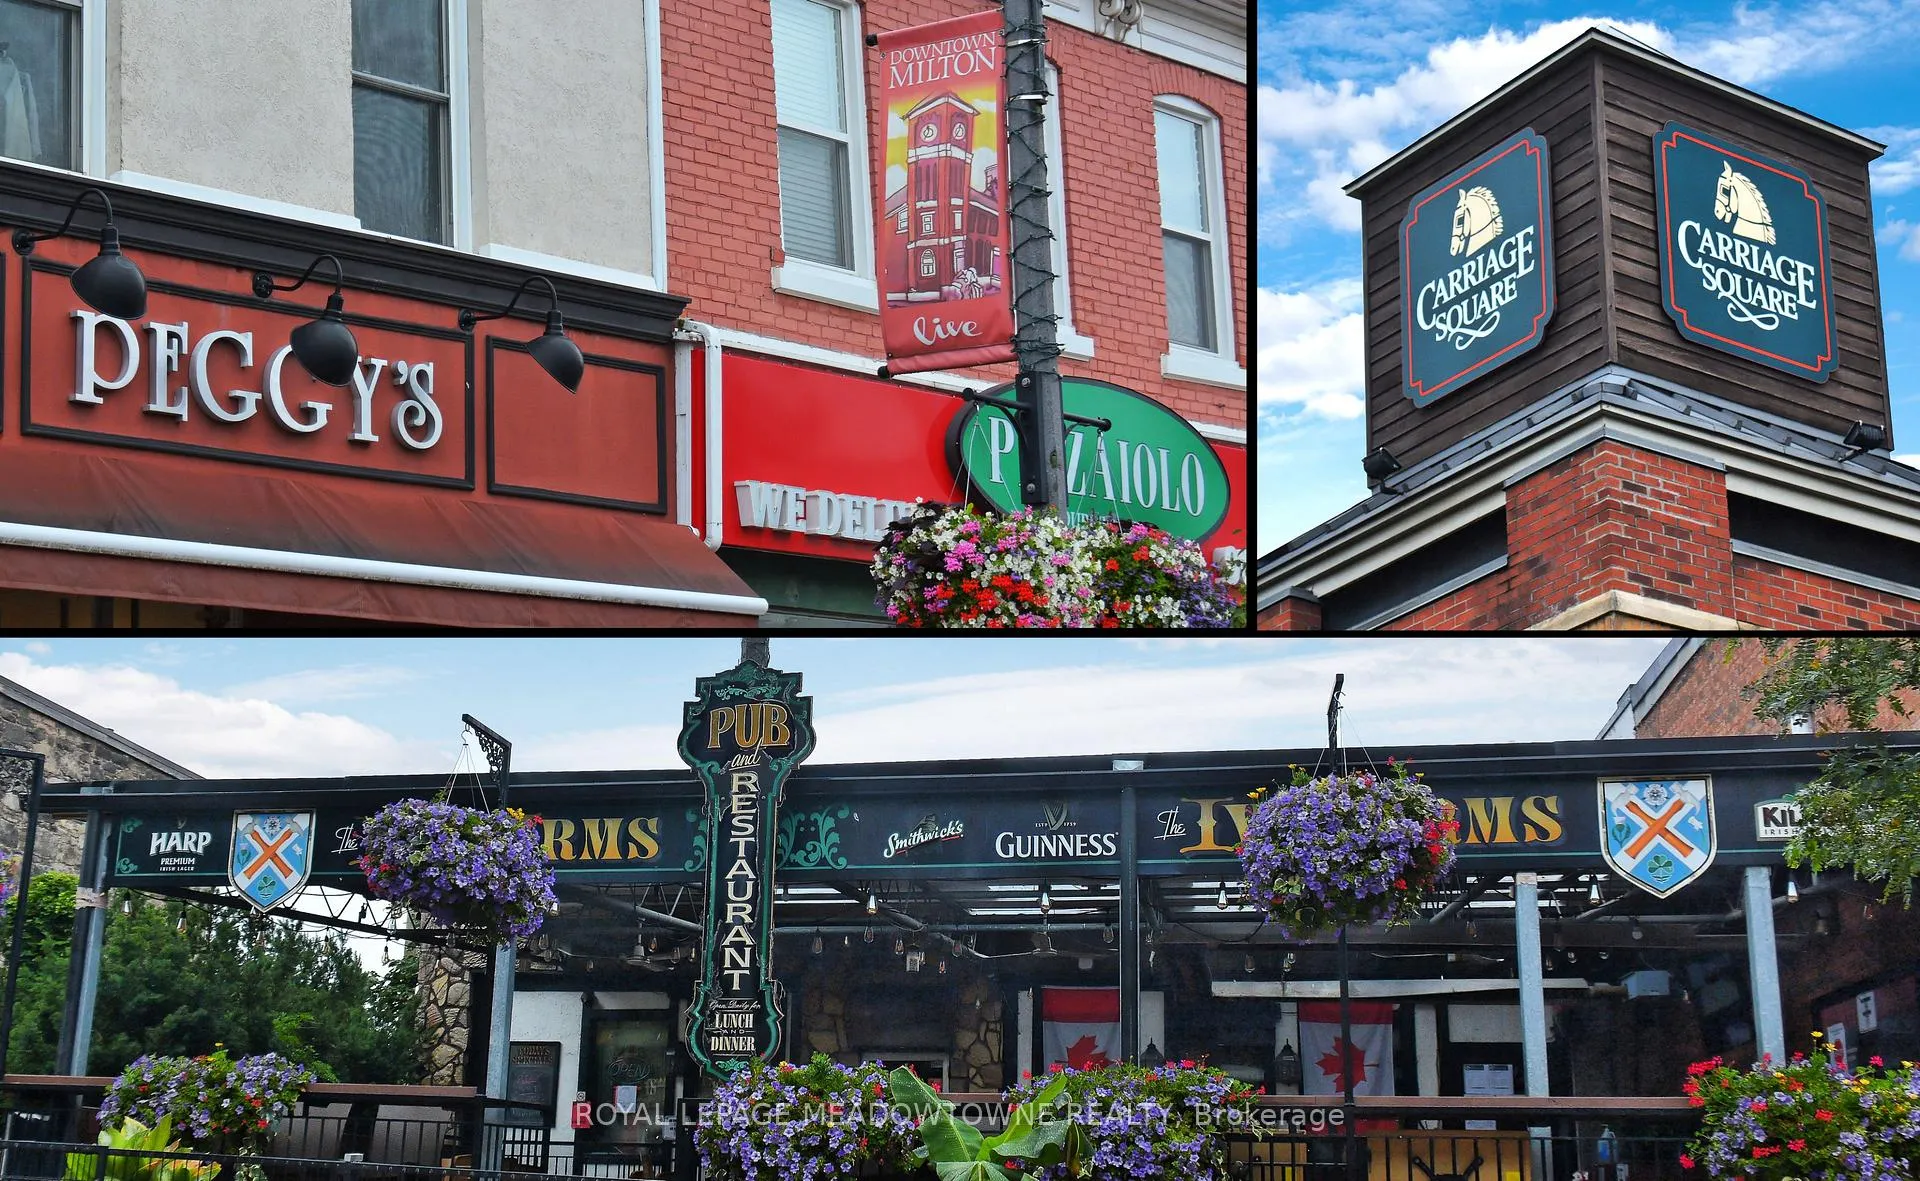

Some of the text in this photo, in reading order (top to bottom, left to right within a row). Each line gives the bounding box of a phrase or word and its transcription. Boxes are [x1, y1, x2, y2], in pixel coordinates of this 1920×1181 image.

[888, 46, 997, 89] MILTON
[890, 31, 996, 66] DOWNTOWN
[1416, 225, 1535, 331] CARRIAGE
[1678, 220, 1817, 309] CARRIAGE
[1435, 275, 1518, 350] SQUARE
[1702, 261, 1799, 330] SQUARE
[69, 308, 443, 450] PEGGY'S
[988, 416, 1205, 517] PZAIOLO
[734, 480, 806, 532] WE
[707, 703, 791, 749] PUB
[730, 740, 762, 770] and
[150, 832, 212, 856] HARP
[332, 815, 659, 860] The RMS
[884, 819, 963, 858] Smithwick's
[1154, 805, 1186, 841] The
[160, 857, 196, 866] PREMIUM
[995, 832, 1117, 859] GUINNESS
[721, 771, 759, 992] RESTAURANT
[715, 1013, 754, 1029] LUNCH
[710, 1036, 757, 1051] DINNER
